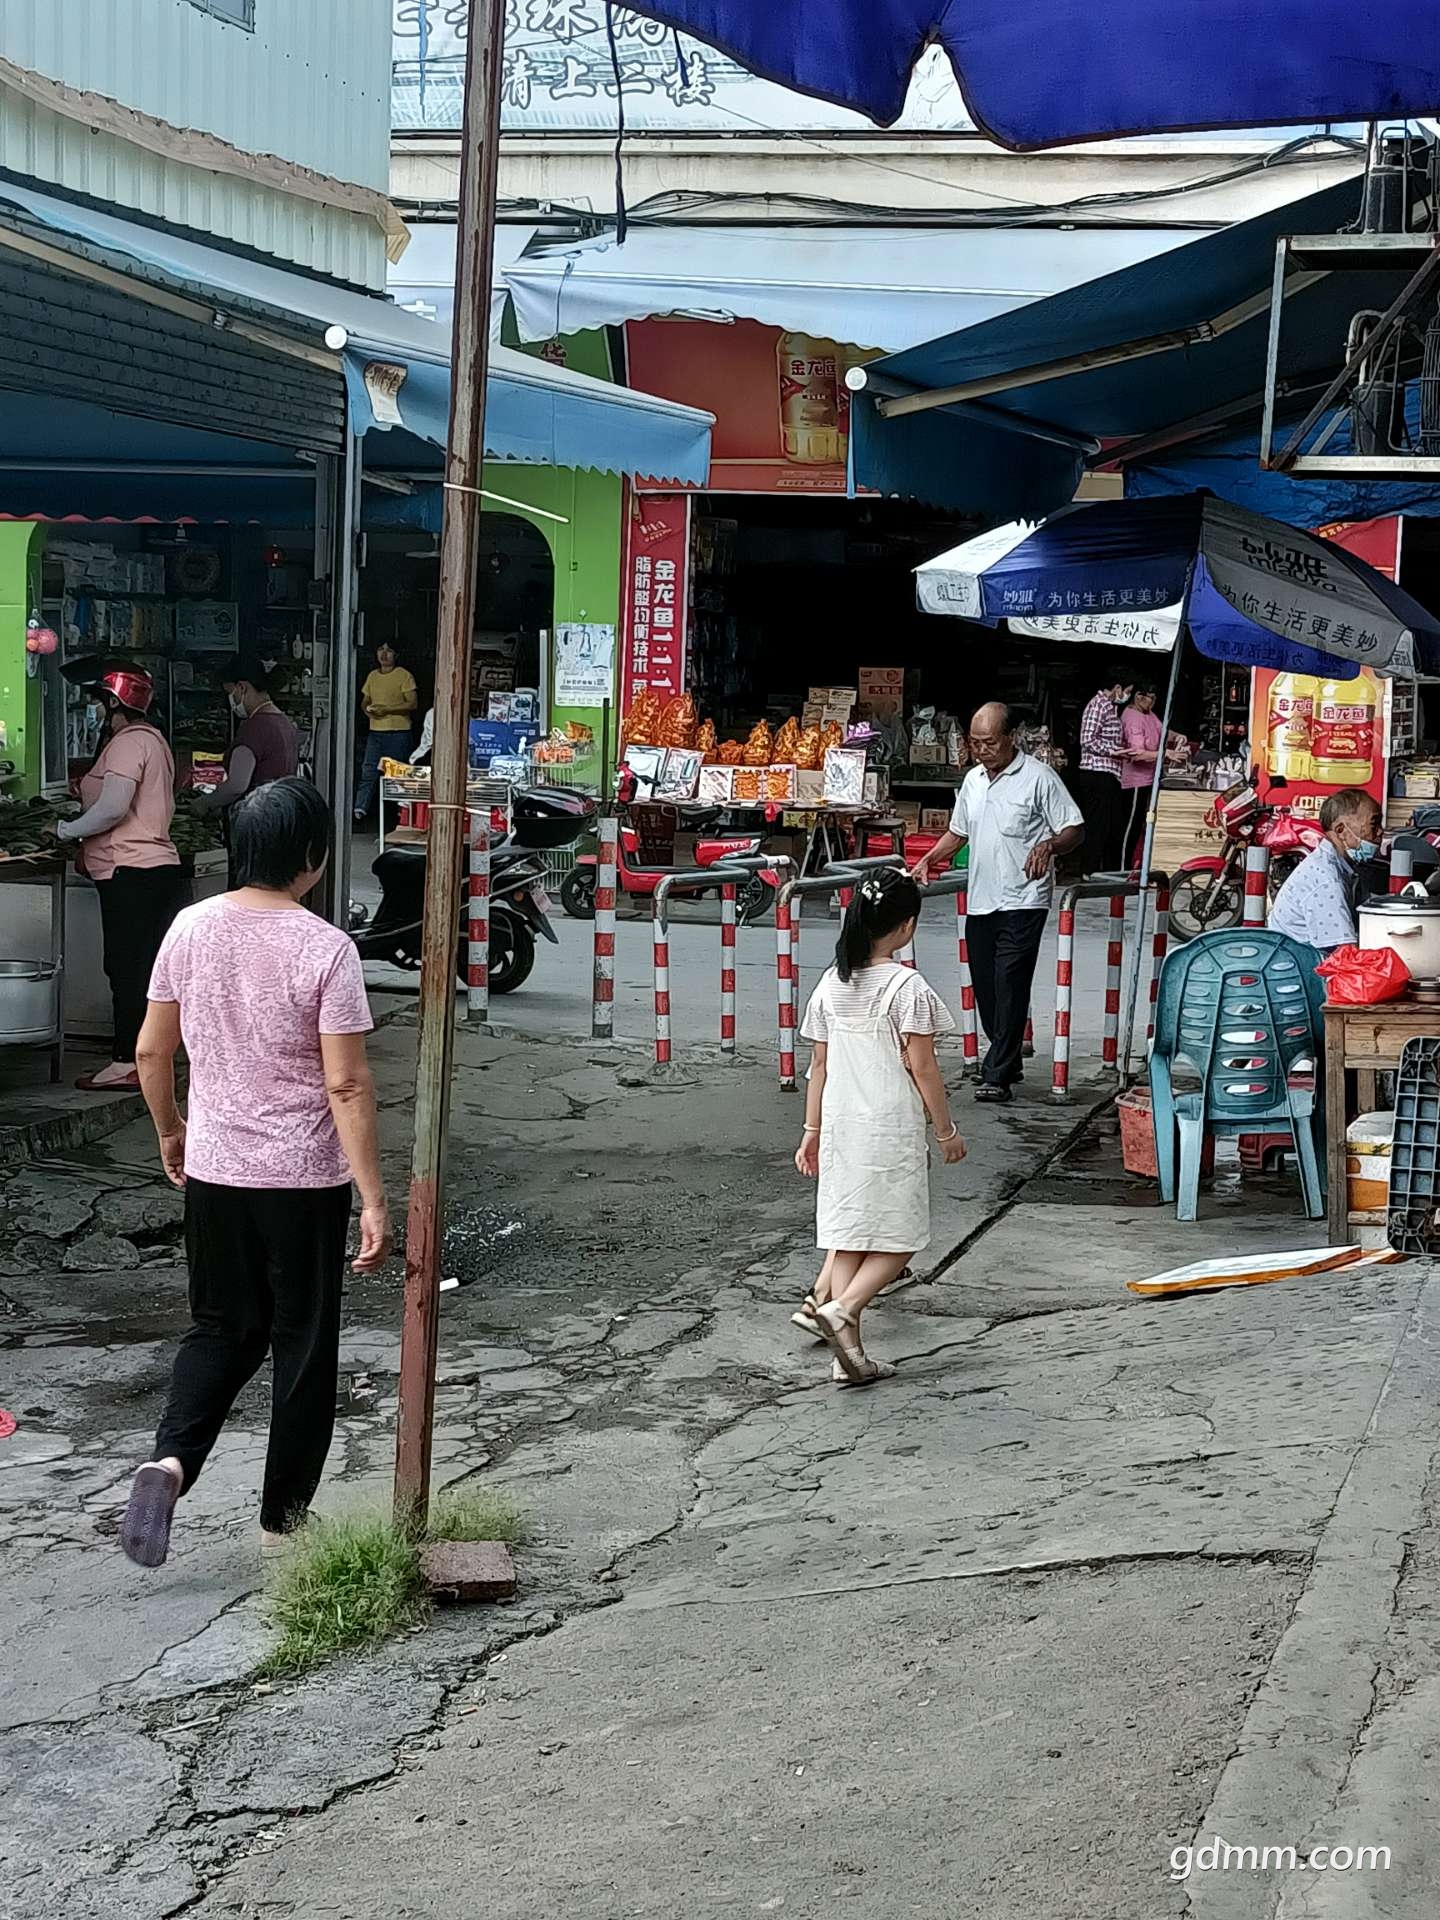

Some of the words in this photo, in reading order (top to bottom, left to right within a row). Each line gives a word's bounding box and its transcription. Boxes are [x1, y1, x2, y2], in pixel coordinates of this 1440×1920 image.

[1047, 587, 1170, 608] 为你生活更美妙
[1222, 584, 1379, 653] 为你生活更美妙
[1323, 706, 1366, 721] 金龙鱼
